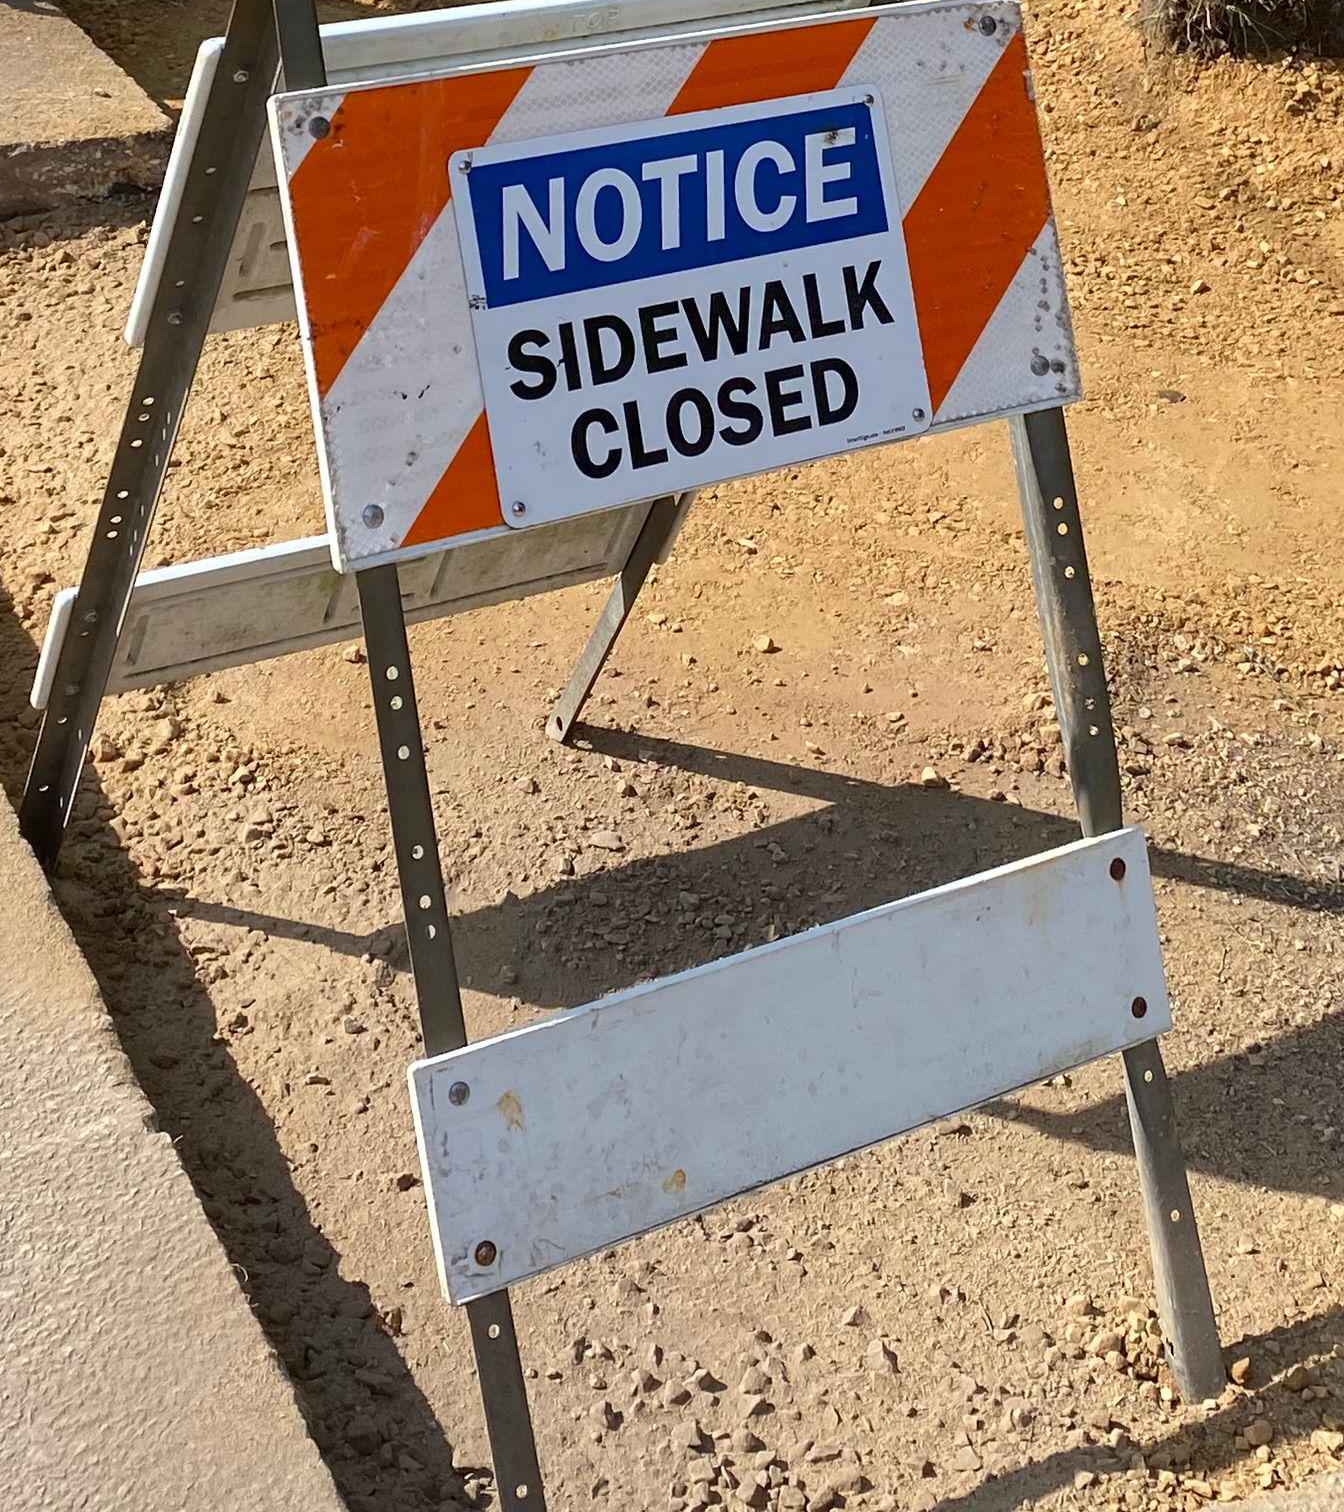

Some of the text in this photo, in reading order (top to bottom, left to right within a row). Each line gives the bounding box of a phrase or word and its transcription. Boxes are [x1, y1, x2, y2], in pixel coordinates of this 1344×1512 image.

[502, 127, 859, 281] NOTICE
[506, 259, 896, 402] SIDEWALK
[570, 357, 861, 480] CLOSED
